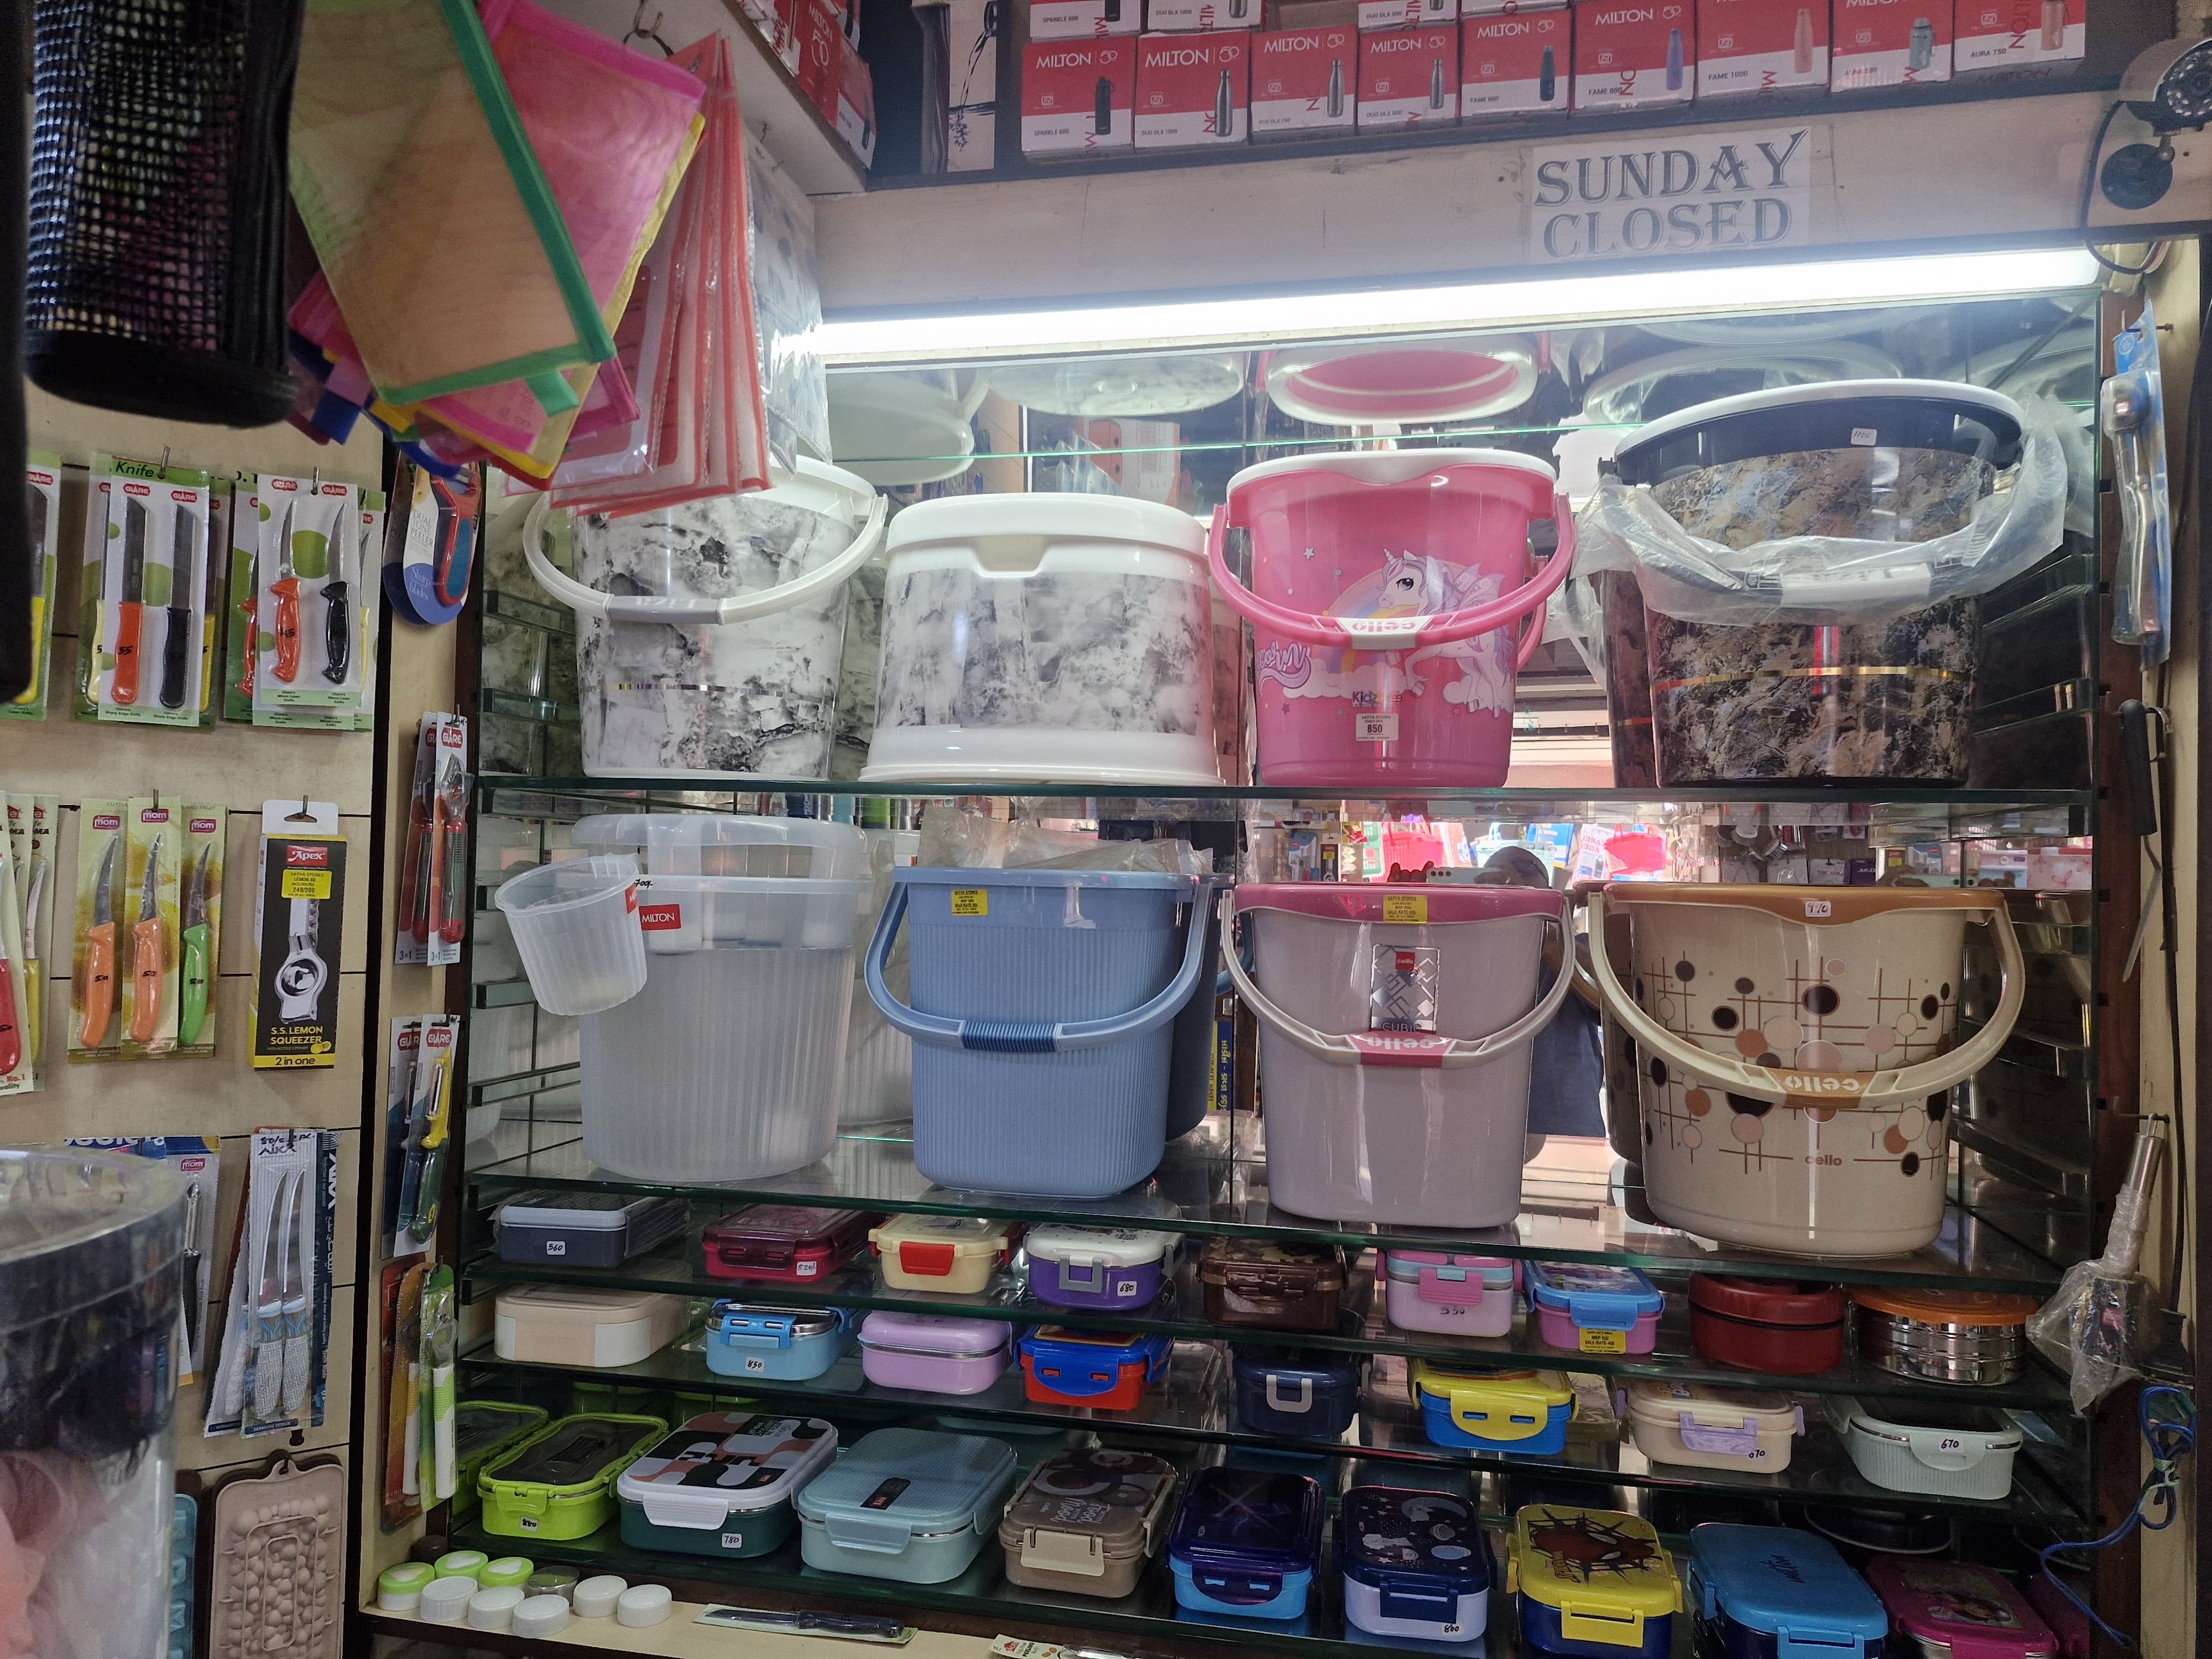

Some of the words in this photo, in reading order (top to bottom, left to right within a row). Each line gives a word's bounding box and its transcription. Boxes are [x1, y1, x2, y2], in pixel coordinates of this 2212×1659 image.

[1595, 8, 1653, 26] MILTON
[1477, 22, 1529, 39] MILTON
[1264, 36, 1319, 53] MILTON
[1370, 38, 1421, 54] MILTON
[1036, 52, 1092, 69] MILTON
[1145, 49, 1208, 67] MILTON
[1534, 129, 1809, 207] SUNDAY
[1543, 198, 1792, 259] CLOSED
[116, 461, 154, 478] Knife
[124, 485, 149, 495] GLARE
[323, 486, 346, 495] GLARE
[172, 492, 196, 502] GLARE
[1353, 620, 1415, 633] cello
[1367, 724, 1383, 733] 850
[443, 731, 462, 745] GLARE
[143, 811, 166, 821] mom
[95, 819, 118, 827] mom
[191, 822, 214, 830] mom
[288, 851, 325, 862] Apex
[642, 913, 675, 923] MILTON
[1383, 1022, 1422, 1032] CUBIC
[270, 1036, 322, 1045] SQUEEZER
[399, 1034, 420, 1048] GLAR
[428, 1031, 451, 1046] GLARE
[1367, 1037, 1434, 1051] cello
[275, 1057, 281, 1066] 2
[284, 1057, 293, 1065] in
[7, 1074, 25, 1082] No.1
[1784, 1076, 1861, 1094] cello
[1804, 1154, 1843, 1167] cello
[548, 1243, 564, 1253] 560
[1120, 1283, 1134, 1292] 680
[747, 1359, 763, 1370] 850
[1940, 1438, 1959, 1449] 670
[724, 1535, 739, 1545] 780
